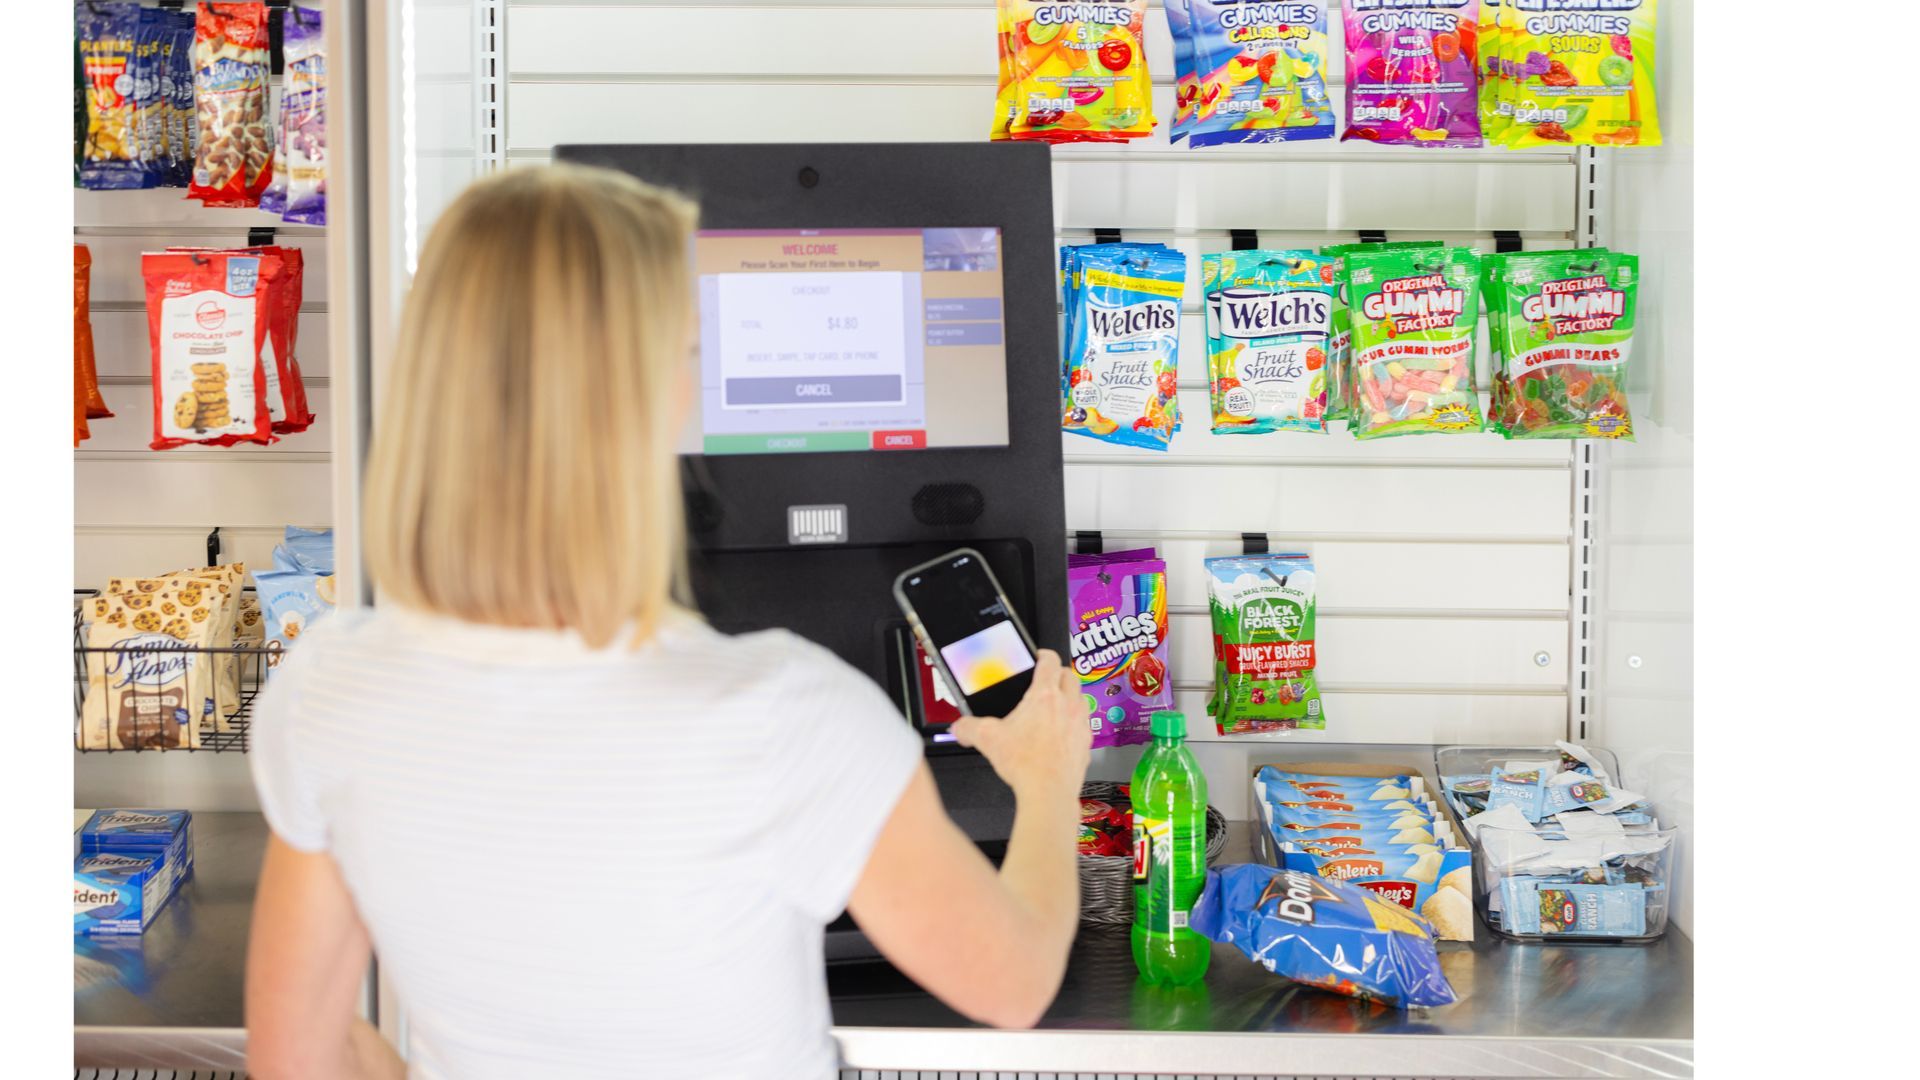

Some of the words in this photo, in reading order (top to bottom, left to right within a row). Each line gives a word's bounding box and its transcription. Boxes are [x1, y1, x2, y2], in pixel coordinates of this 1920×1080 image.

[1034, 5, 1132, 25] GUMMIES
[1219, 4, 1318, 29] GUMMIES
[1362, 11, 1458, 33] GUMMIES
[1077, 26, 1088, 40] 5
[1526, 14, 1630, 35] GUMMIES
[1398, 35, 1424, 45] WILD
[1551, 35, 1601, 54] SOURS
[1391, 46, 1433, 57] BERRIES
[782, 244, 839, 256] WELCOME
[1382, 274, 1446, 293] ORIGINAL
[1542, 275, 1608, 294] ORIGINAL
[1363, 288, 1464, 320] GUMMI
[1523, 290, 1625, 321] GUMMI
[1091, 304, 1175, 337] Welch's
[1226, 297, 1326, 330] Welch's
[827, 316, 858, 330] $4.80
[1396, 313, 1456, 333] FACTORY
[1555, 317, 1614, 336] FACTORY
[173, 331, 223, 340] CHOCOLATE
[1388, 345, 1428, 355] GUMMI
[1432, 340, 1470, 355] WORMS
[1254, 350, 1297, 367] Fruit
[1525, 349, 1571, 366] GUMMI
[1575, 348, 1620, 361] BEARS
[1111, 360, 1149, 374] Fruit
[1242, 363, 1303, 382] Snacks
[1099, 371, 1153, 387] Snacks
[795, 384, 833, 396] CANCEL
[885, 435, 914, 446] CANCEL
[1246, 605, 1295, 617] BLACK
[1244, 616, 1300, 629] FOREST
[1070, 612, 1157, 658] kittles
[1075, 633, 1158, 676] Gummies
[1237, 646, 1272, 661] JUICY
[1274, 644, 1312, 660] BURST
[113, 657, 189, 689] Amos
[83, 858, 152, 866] Trident
[74, 889, 118, 904] ident
[1587, 892, 1598, 930] RANCH
